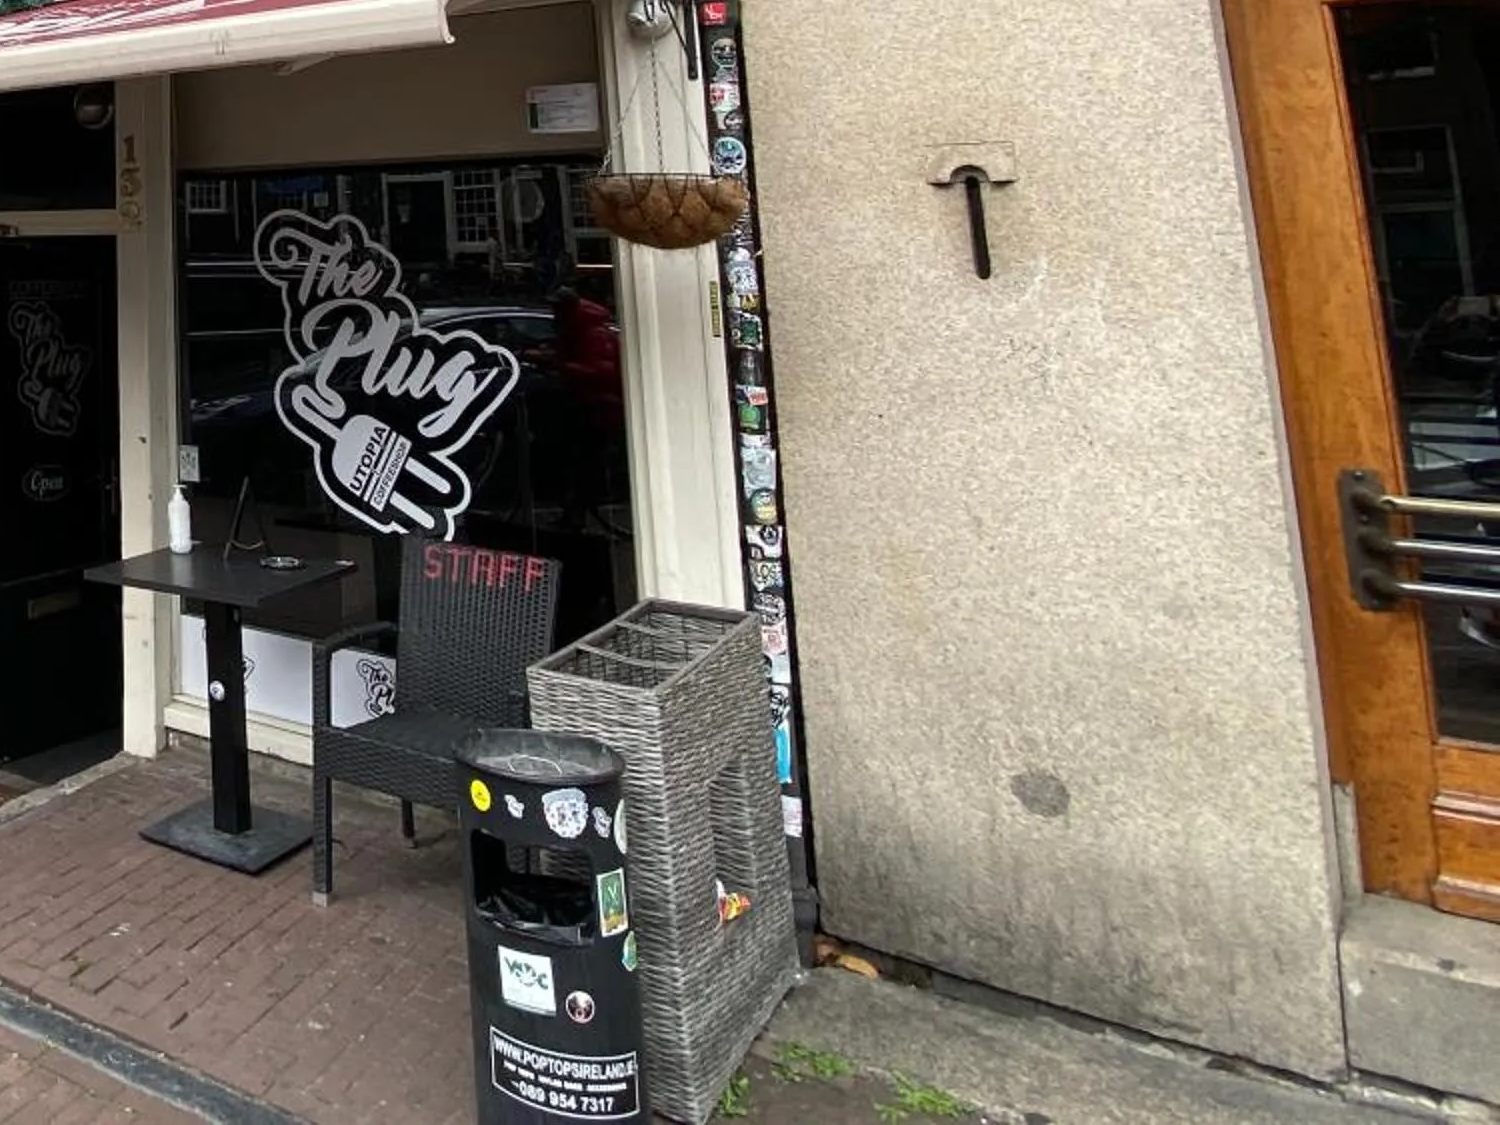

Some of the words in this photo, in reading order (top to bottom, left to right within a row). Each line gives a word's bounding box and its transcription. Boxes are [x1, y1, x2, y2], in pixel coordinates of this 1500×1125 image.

[269, 226, 384, 304] The
[302, 297, 499, 438] Plug
[30, 471, 66, 499] Open
[349, 427, 387, 492] UTOPIA
[423, 544, 546, 592] STAFF
[519, 1080, 546, 1103] 089
[549, 1090, 577, 1111] 954
[579, 1095, 615, 1113] 7317
